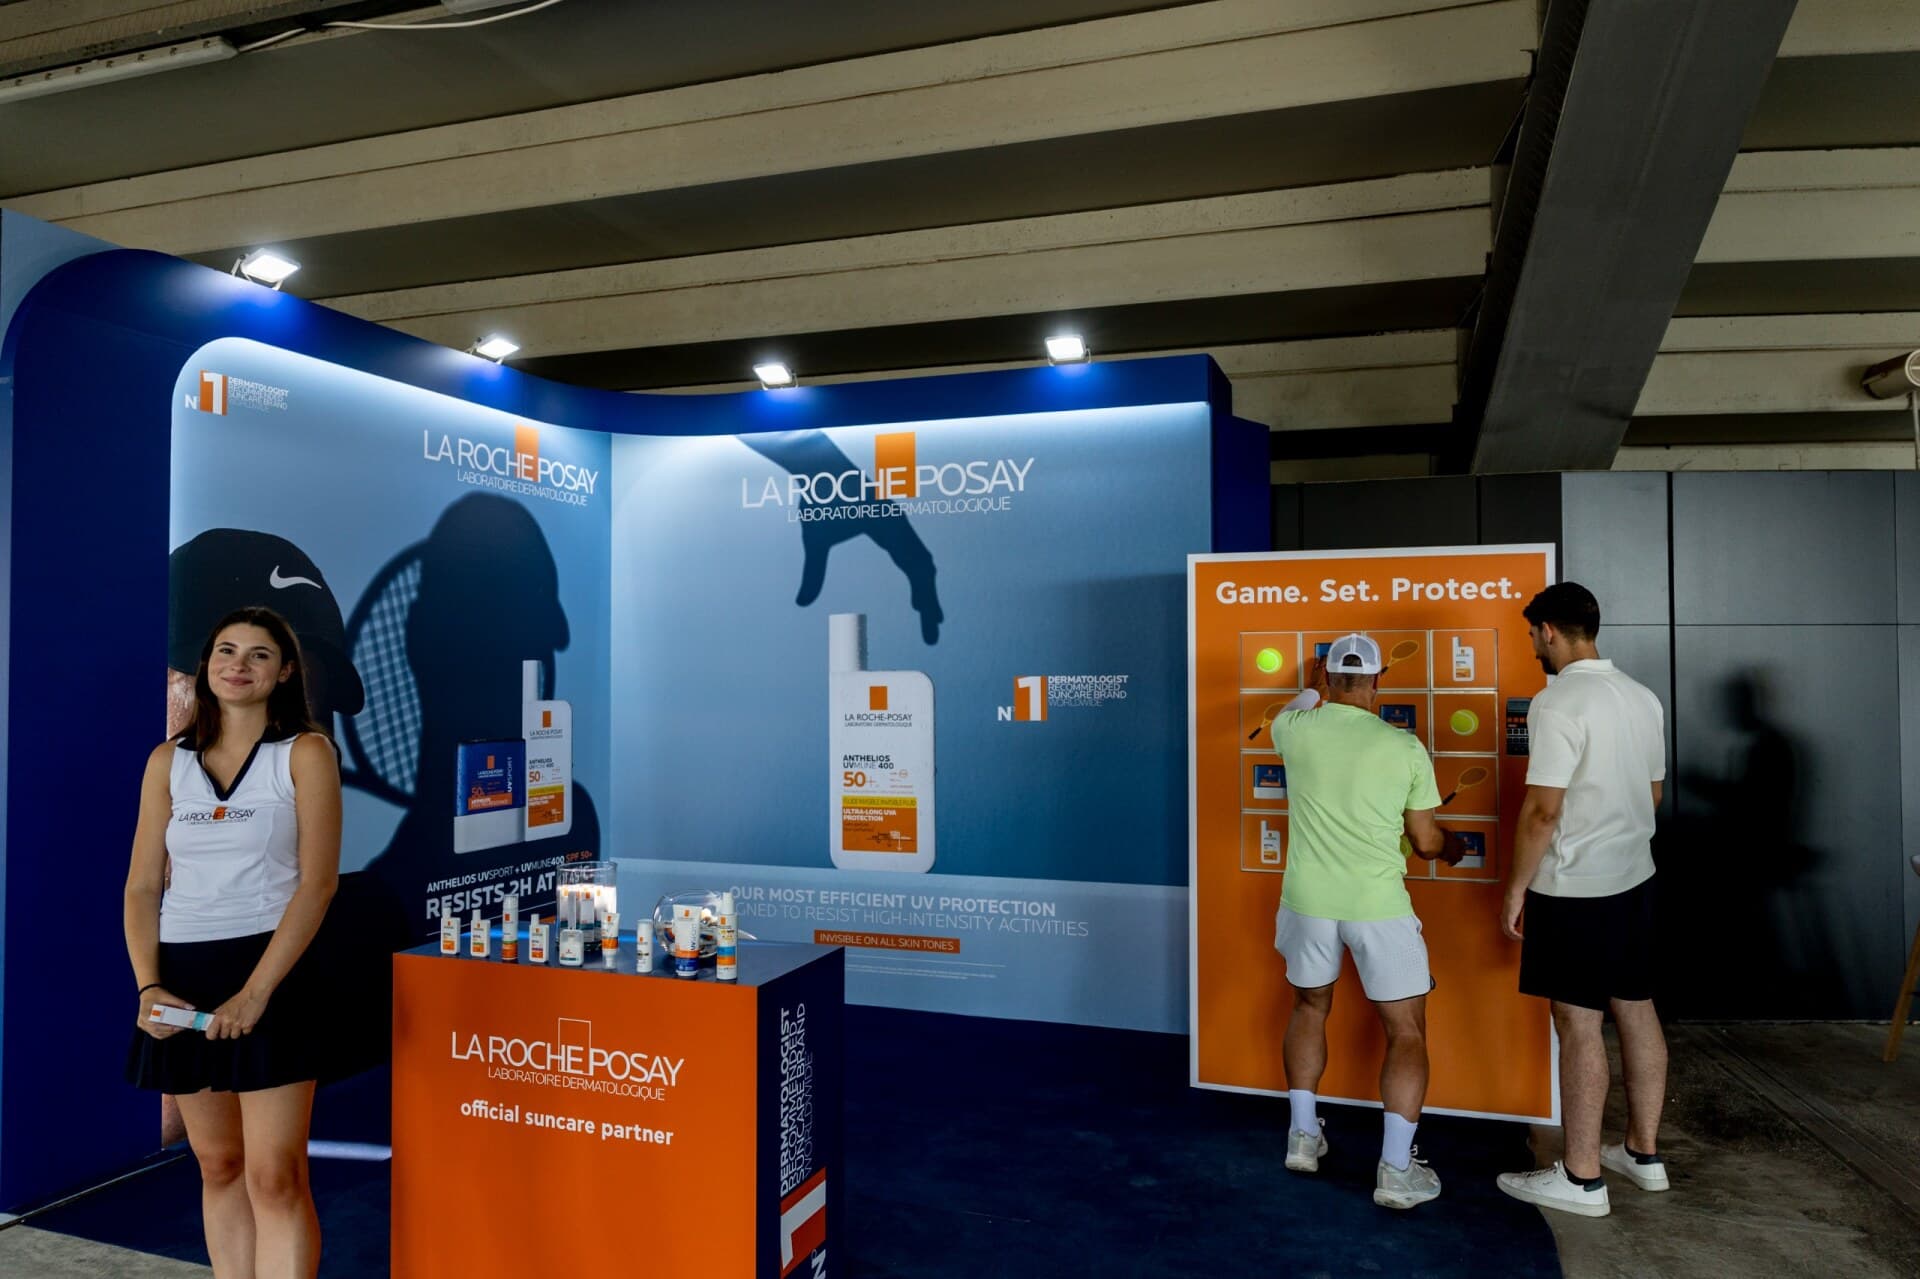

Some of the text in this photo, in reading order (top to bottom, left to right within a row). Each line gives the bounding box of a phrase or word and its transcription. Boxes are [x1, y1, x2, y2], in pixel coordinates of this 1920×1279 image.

[423, 429, 599, 495] LA ROCHE POSAY
[457, 469, 588, 506] LABORATOIRE DERMATOLOGIQUE
[742, 457, 1035, 508] LA ROCHE POSAY
[788, 496, 1012, 523] LABORATOIRE DERMATOLOGIQUE
[1215, 577, 1523, 604] Game. Set. Protect.
[1047, 675, 1128, 684] DERMATOLOGIST
[1047, 683, 1120, 692] RECOMMENDED
[1047, 690, 1127, 700] SUNCARE BRAND
[844, 713, 854, 721] LA
[843, 754, 891, 762] ANTHELIOS
[843, 762, 895, 770] UVMUNE 400
[179, 814, 189, 822] LA
[224, 809, 256, 820] POSAY
[427, 873, 477, 893] ANTHELIOS
[478, 866, 515, 882] UVSPORT
[426, 883, 505, 920] RESISTS
[509, 877, 532, 897] 2H
[536, 871, 556, 893] AT
[730, 886, 1056, 917] OUR MOST EFFICIENT UV PROTECTION
[783, 904, 801, 919] TO
[805, 906, 858, 923] RESIST
[863, 910, 993, 931] HIGH-INTENSITY
[999, 918, 1090, 937] ACTIVITIES
[820, 932, 954, 951] INVISIBLE ON ALL SKIN TONES
[451, 1030, 685, 1087] LA ROCHE POSAY
[488, 1066, 665, 1101] LABORATOIRE DERMATOLOGIQUE
[796, 1002, 805, 1185] SUNCARE BRAND
[780, 1008, 790, 1198] DERMATOLOGIST
[788, 1021, 798, 1191] RECOMMENDED
[460, 1099, 674, 1145] official suncare partner
